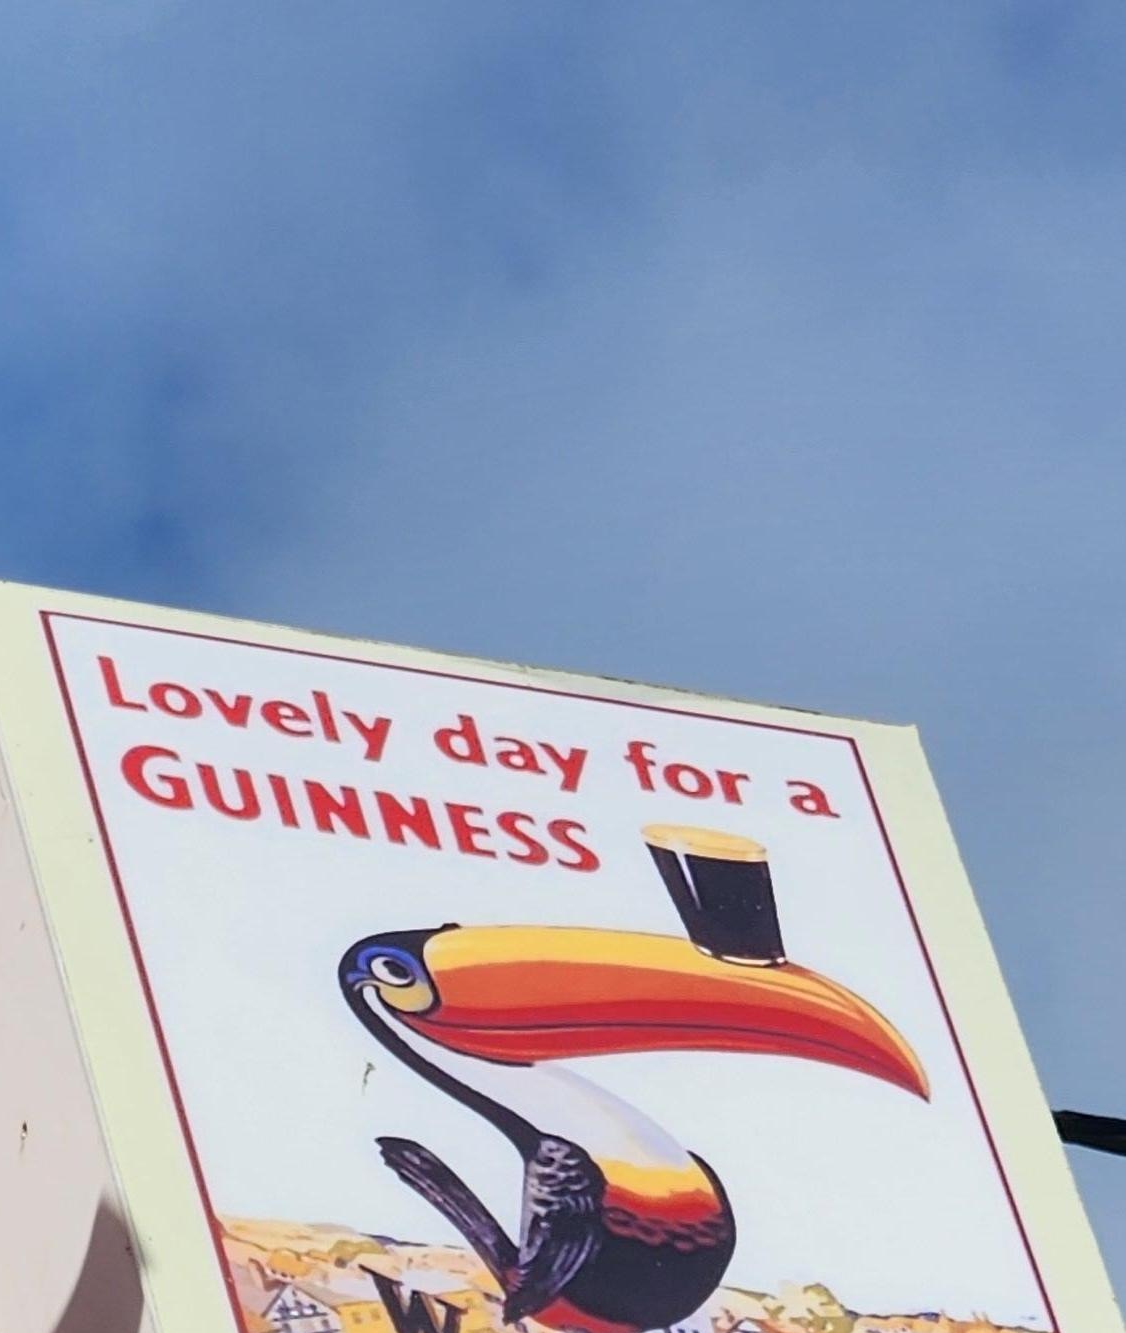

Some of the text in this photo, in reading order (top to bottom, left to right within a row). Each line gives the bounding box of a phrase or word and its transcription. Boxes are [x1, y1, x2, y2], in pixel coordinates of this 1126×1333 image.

[97, 655, 840, 819] Lovely day for a
[119, 744, 601, 873] GUINNESS
